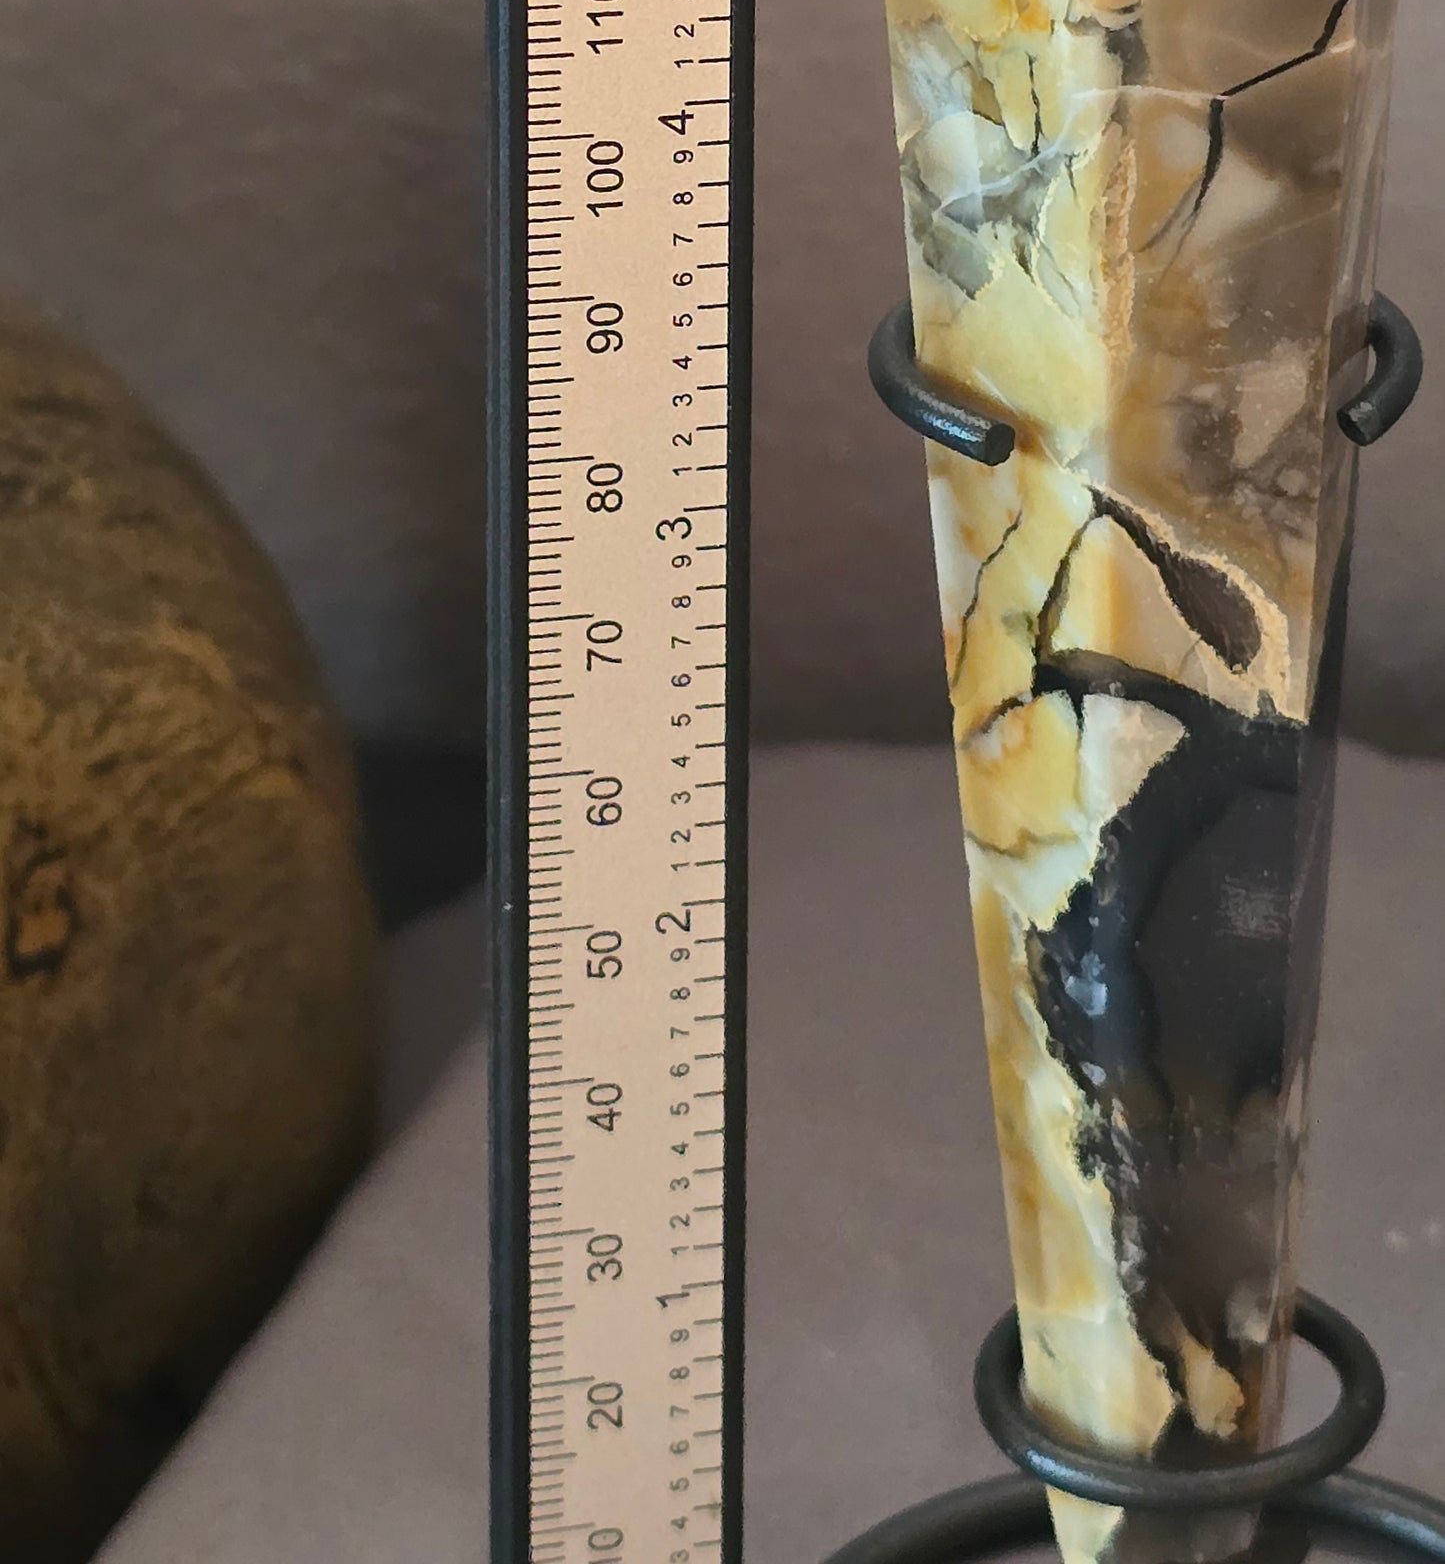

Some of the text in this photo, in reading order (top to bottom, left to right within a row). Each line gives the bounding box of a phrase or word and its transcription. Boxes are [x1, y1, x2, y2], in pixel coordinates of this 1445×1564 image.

[673, 23, 695, 39] 2
[673, 58, 695, 69] 1
[657, 108, 695, 136] 4
[672, 149, 695, 165] 9
[586, 140, 625, 218] 100
[671, 190, 695, 206] 8
[672, 232, 694, 247] 7
[671, 271, 694, 287] 6
[586, 301, 625, 355] 90
[672, 312, 694, 328] 5
[671, 355, 693, 371] 4
[671, 392, 694, 408] 3
[671, 431, 693, 448] 2
[671, 466, 693, 477] 1
[586, 462, 624, 514] 80
[654, 516, 693, 542] 3
[670, 554, 693, 569] 9
[670, 594, 692, 609] 8
[586, 619, 624, 673] 70
[670, 635, 692, 650] 7
[670, 672, 692, 688] 6
[670, 712, 692, 728] 5
[670, 754, 691, 769] 4
[586, 776, 624, 827] 60
[670, 790, 692, 805] 3
[670, 828, 692, 844] 2
[670, 861, 690, 872] 1
[654, 908, 692, 935] 2
[586, 930, 624, 980] 50
[669, 947, 691, 963] 9
[669, 986, 691, 1001] 8
[669, 1026, 690, 1040] 7
[669, 1062, 691, 1079] 6
[586, 1082, 624, 1133] 40
[669, 1101, 691, 1116] 5
[670, 1141, 689, 1156] 4
[669, 1176, 691, 1191] 3
[669, 1214, 691, 1229] 2
[586, 1233, 624, 1283] 30
[670, 1246, 689, 1256] 1
[655, 1291, 691, 1309] 1
[669, 1328, 690, 1344] 9
[669, 1366, 690, 1381] 8
[586, 1381, 624, 1431] 20
[669, 1405, 689, 1417] 7
[669, 1441, 689, 1455] 6
[669, 1478, 690, 1492] 5
[670, 1515, 688, 1530] 4
[668, 1548, 690, 1564] 3
